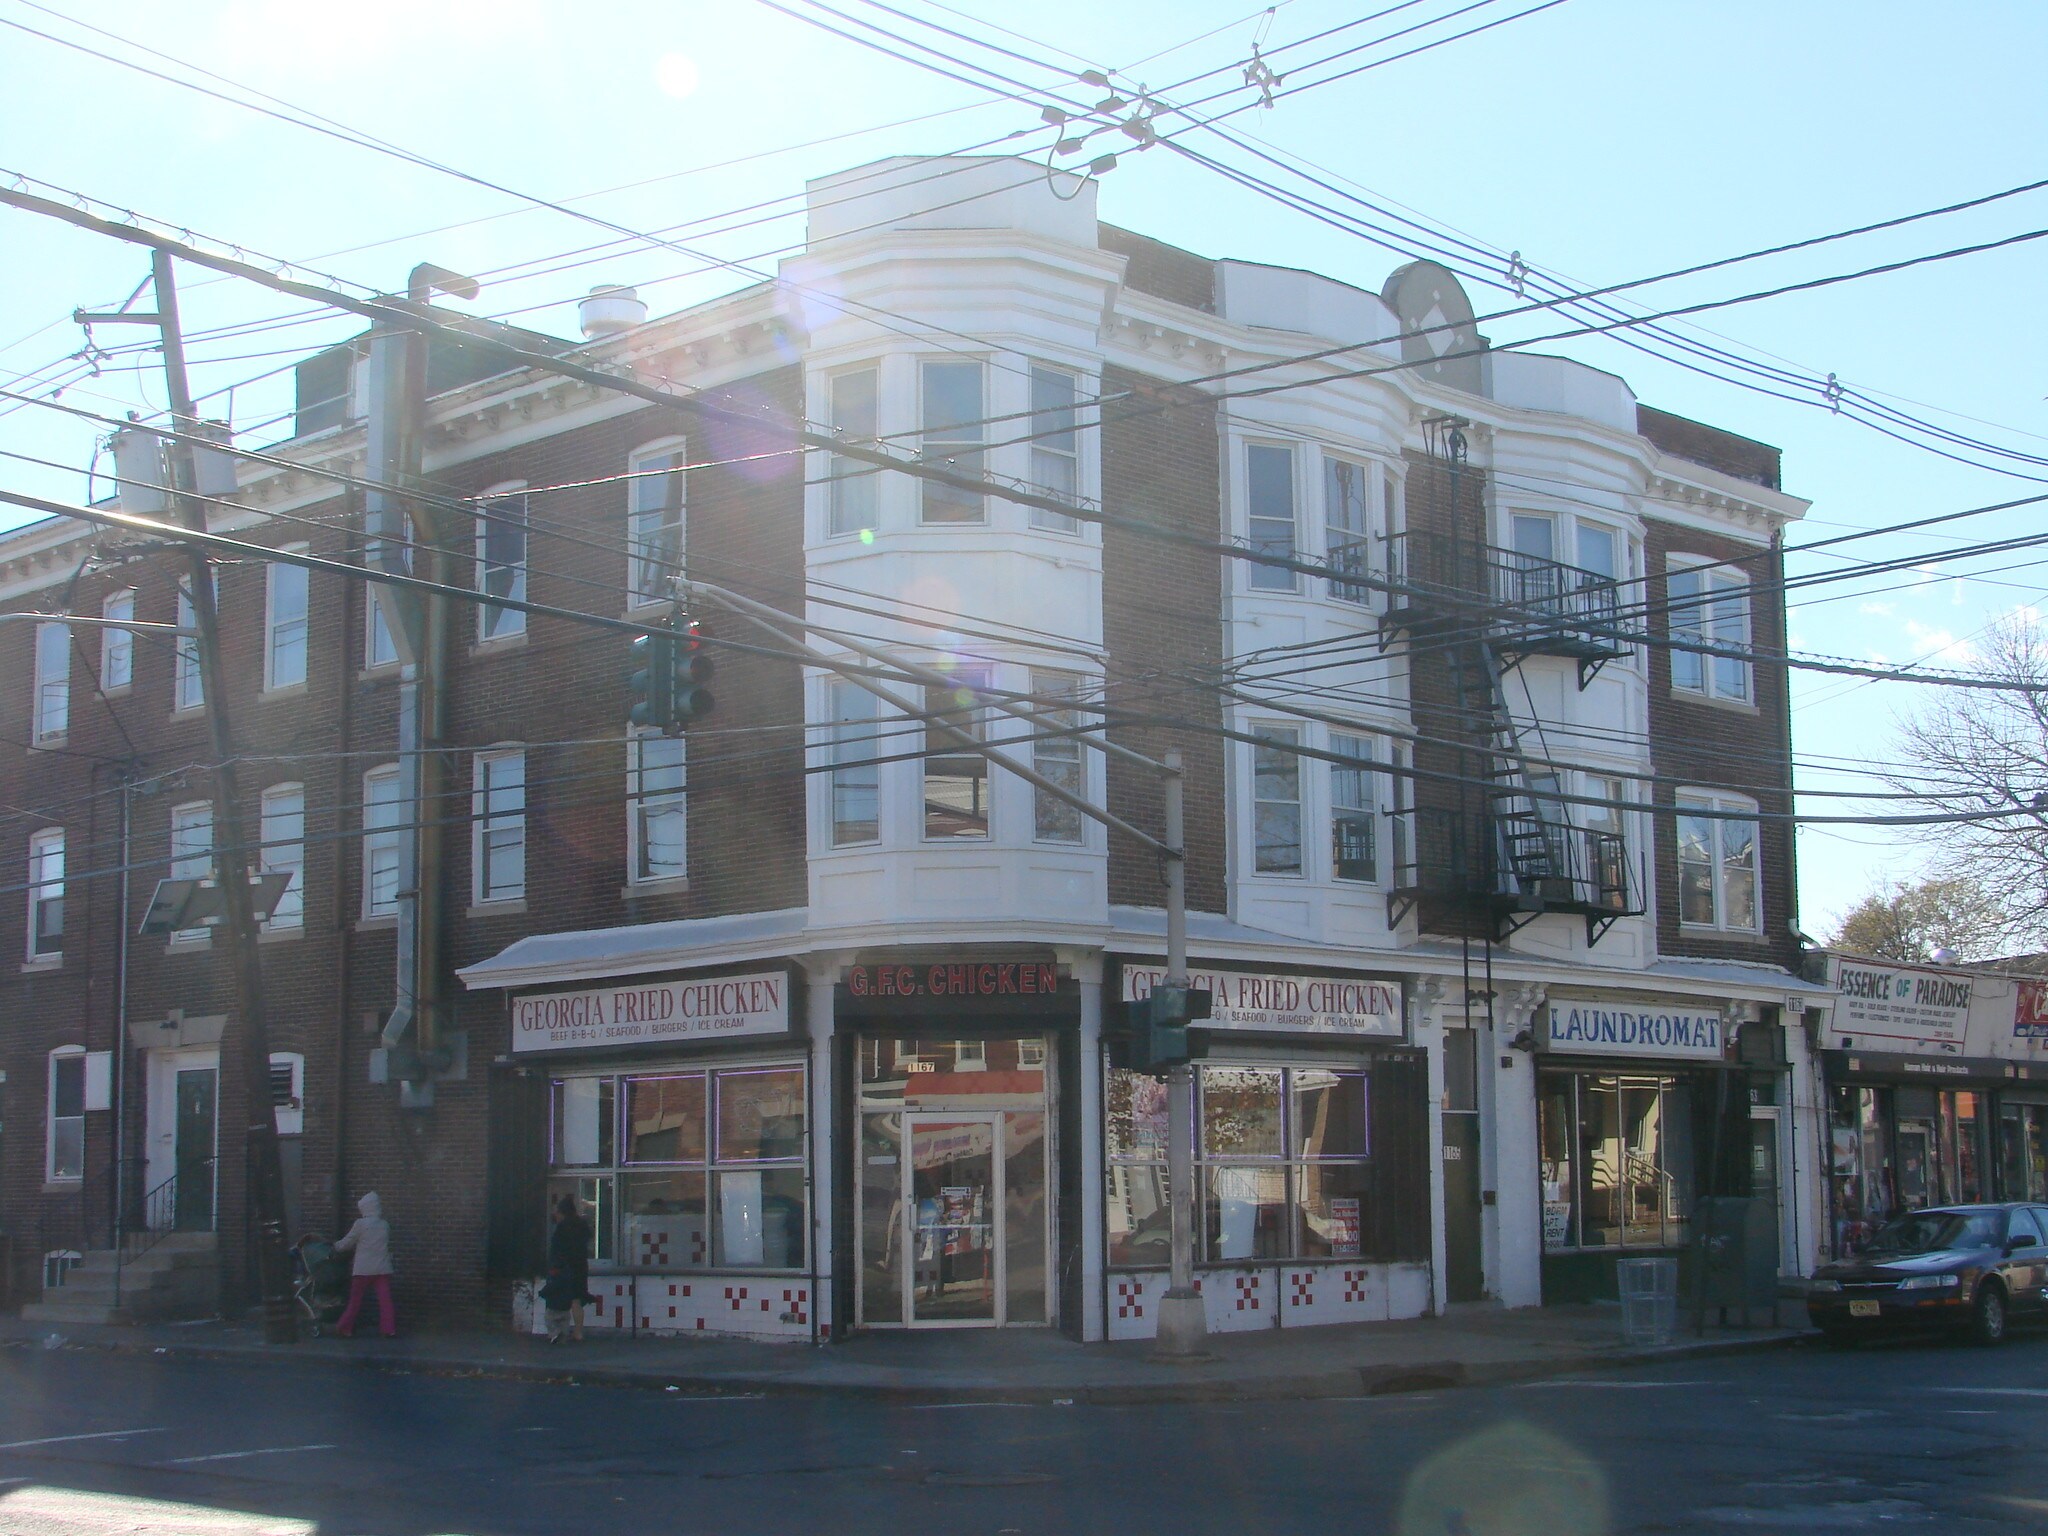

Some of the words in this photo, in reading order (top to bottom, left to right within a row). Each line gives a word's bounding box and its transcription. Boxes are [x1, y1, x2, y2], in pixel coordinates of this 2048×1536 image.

[927, 963, 1057, 995] CHICKEN
[1238, 977, 1300, 1012] FRIED
[1307, 981, 1394, 1016] CHICKEN
[1840, 968, 1891, 1000] ESSENCE
[1896, 978, 1911, 997] OF
[1914, 978, 1970, 1009] PARADISE
[520, 996, 604, 1032] GEORGIA
[614, 989, 673, 1024] FRIED
[682, 979, 780, 1018] CHICKEN
[1231, 1011, 1267, 1023] SEAFOOD
[1277, 1014, 1315, 1026] BURGERS
[1324, 1016, 1337, 1027] ICE
[1339, 1017, 1365, 1028] CREAM
[551, 1030, 568, 1042] BEEF
[606, 1025, 641, 1038] SEAFOOD
[652, 1022, 688, 1035] BURGERS
[698, 1019, 711, 1031] ICE
[714, 1017, 745, 1029] CREAM
[1551, 1008, 1719, 1048] LAUNDROMAT
[909, 1062, 935, 1072] 1167
